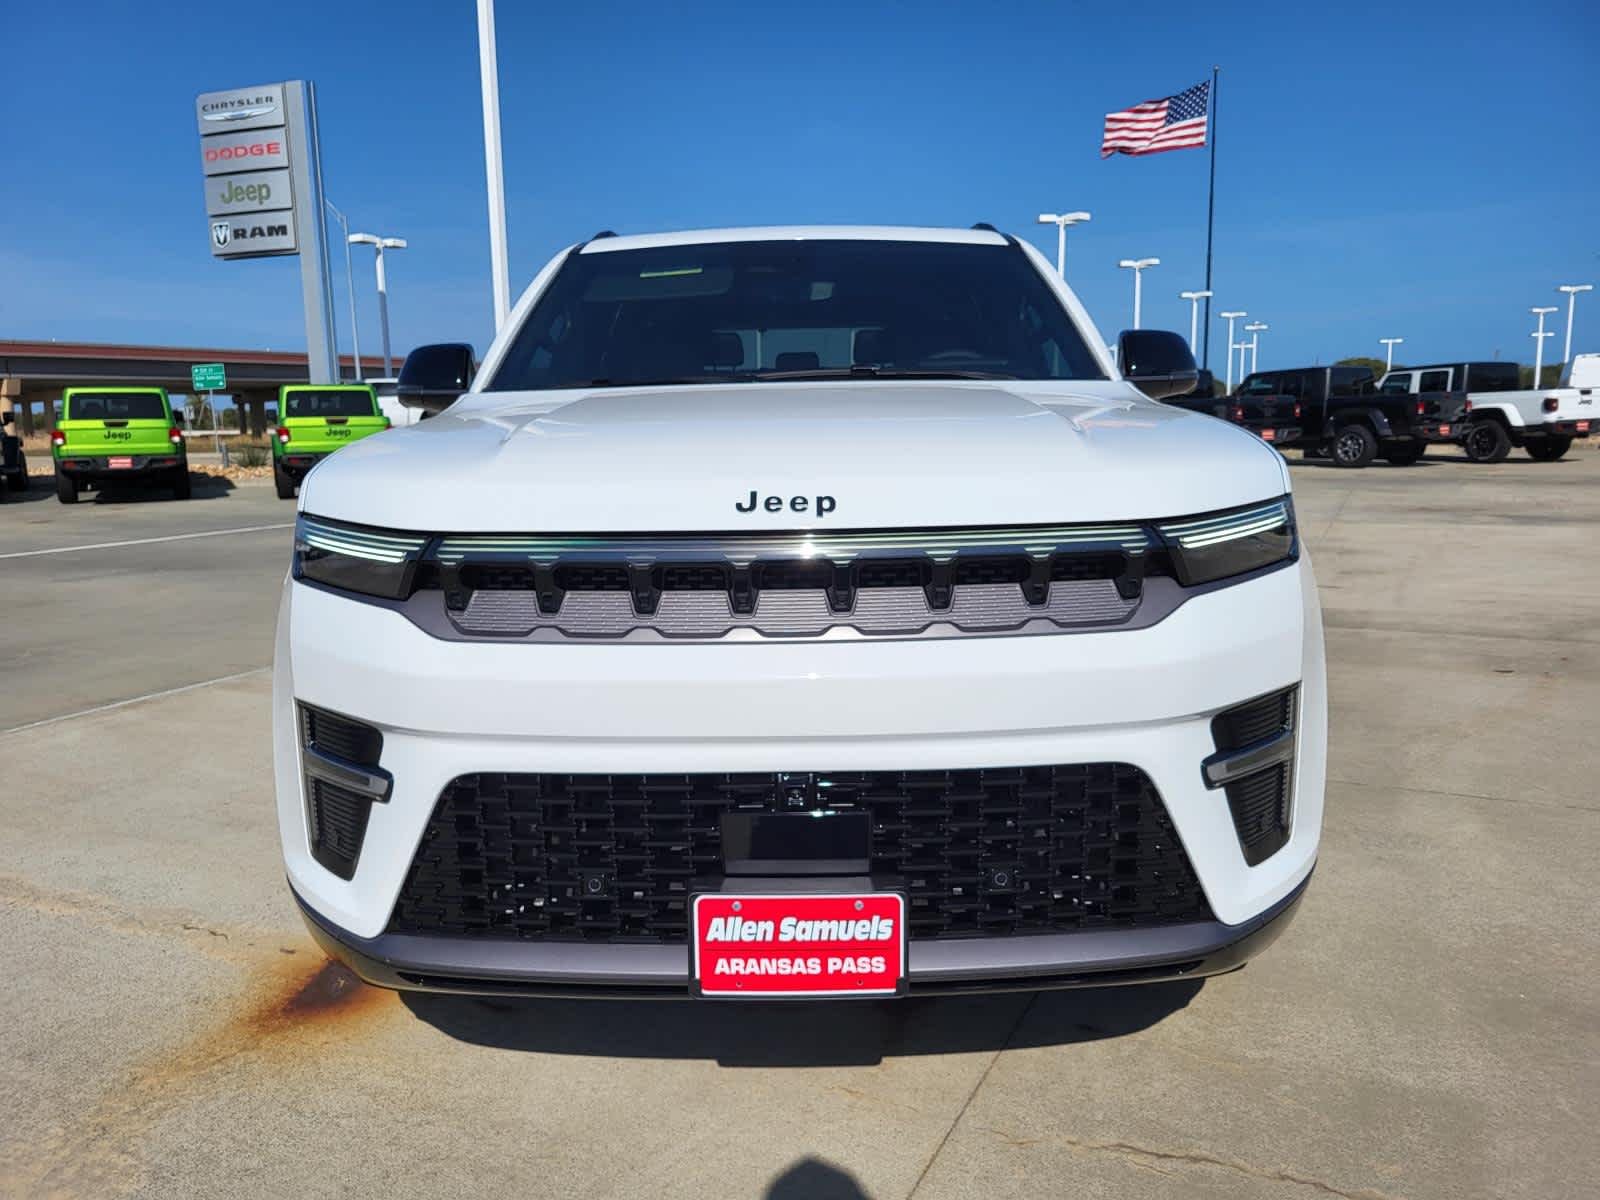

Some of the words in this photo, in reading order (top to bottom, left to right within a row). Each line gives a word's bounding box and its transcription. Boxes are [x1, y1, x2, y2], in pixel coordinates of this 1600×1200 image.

[202, 96, 273, 112] CHRYSLER
[205, 142, 281, 161] DODGE
[220, 181, 271, 205] Jeep
[233, 225, 288, 240] RAM
[104, 430, 132, 441] Jeep
[735, 490, 837, 518] Jeep
[706, 916, 774, 942] Allen
[778, 915, 894, 942] Samuels
[714, 957, 821, 975] ARANSAS
[827, 956, 886, 974] PASS
